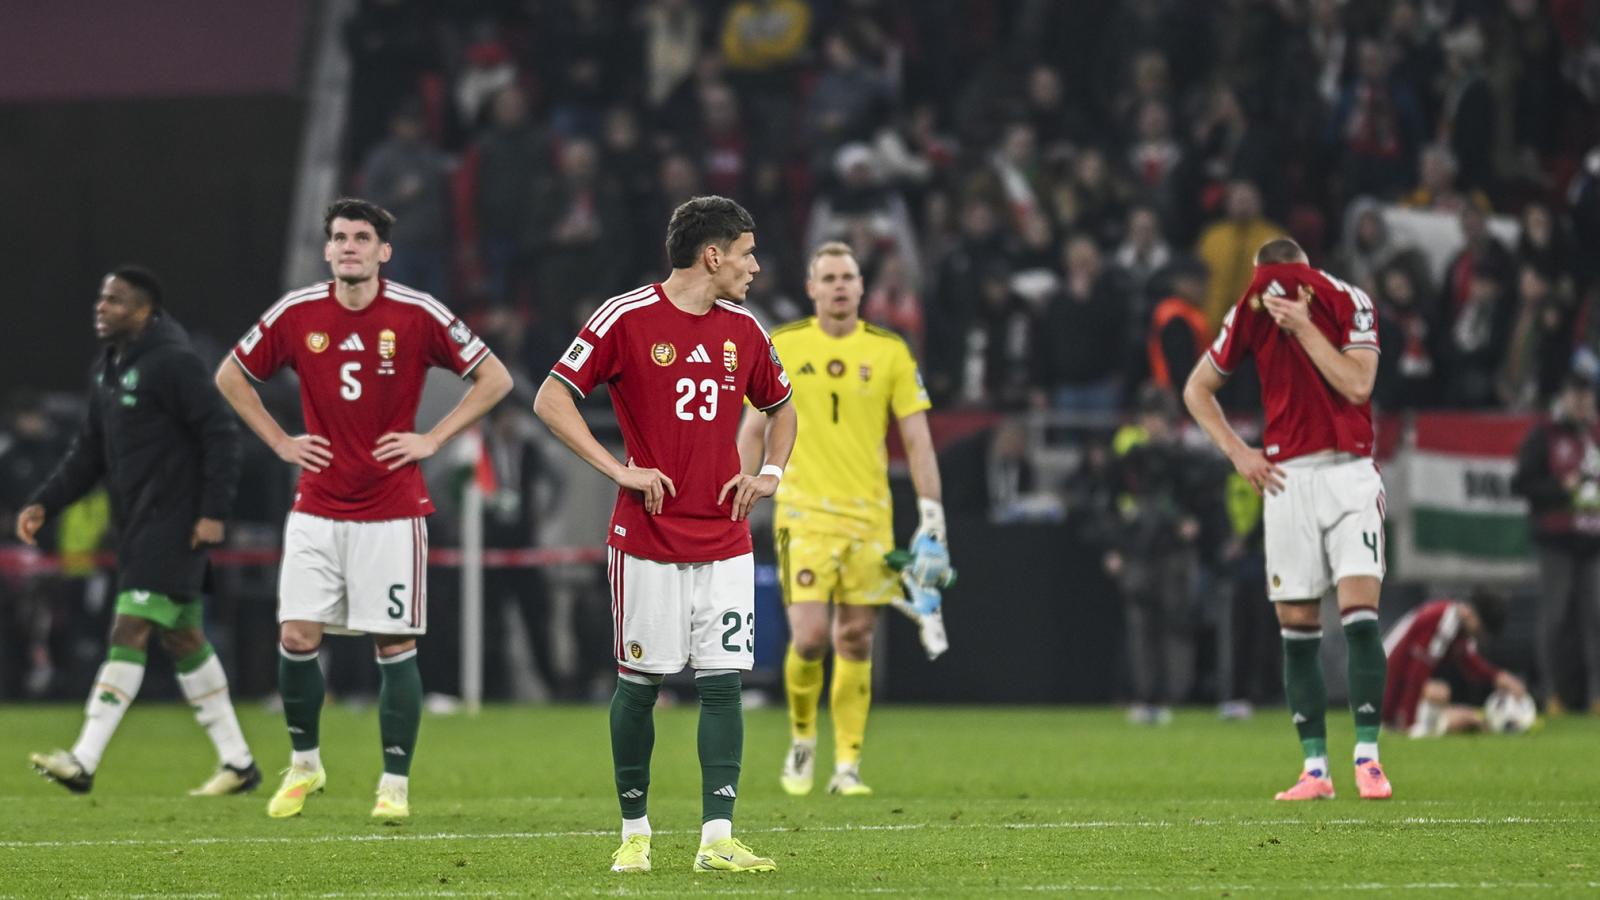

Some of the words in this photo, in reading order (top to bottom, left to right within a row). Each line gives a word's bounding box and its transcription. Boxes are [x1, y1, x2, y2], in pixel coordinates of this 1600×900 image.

[340, 361, 362, 401] 5
[675, 377, 719, 421] 23
[831, 391, 839, 424] 1
[1362, 530, 1378, 564] 4
[387, 583, 406, 620] 5
